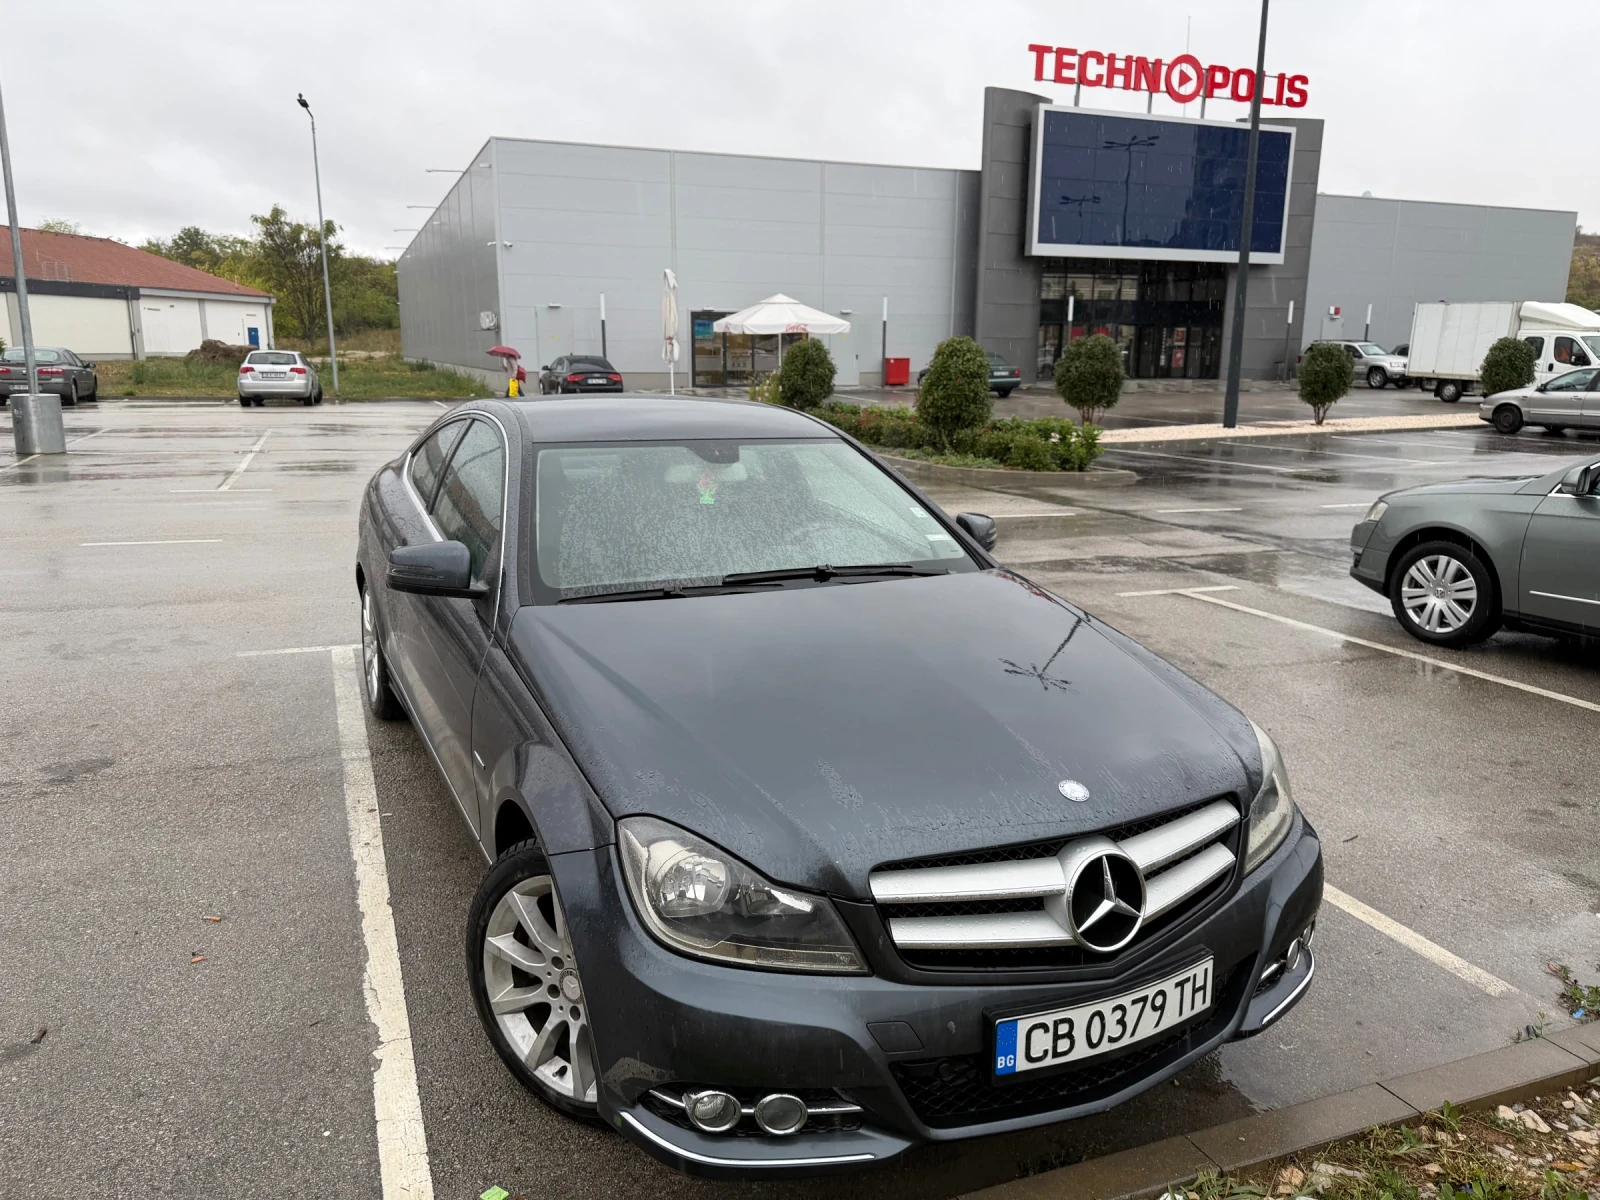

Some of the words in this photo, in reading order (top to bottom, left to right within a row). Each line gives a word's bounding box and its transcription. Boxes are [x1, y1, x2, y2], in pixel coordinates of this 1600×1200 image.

[1028, 44, 1309, 108] TECHNOPOLIS
[1024, 1016, 1076, 1064] CB
[1085, 988, 1168, 1050] 0379
[1174, 966, 1209, 1018] TH
[997, 1055, 1015, 1069] BG
